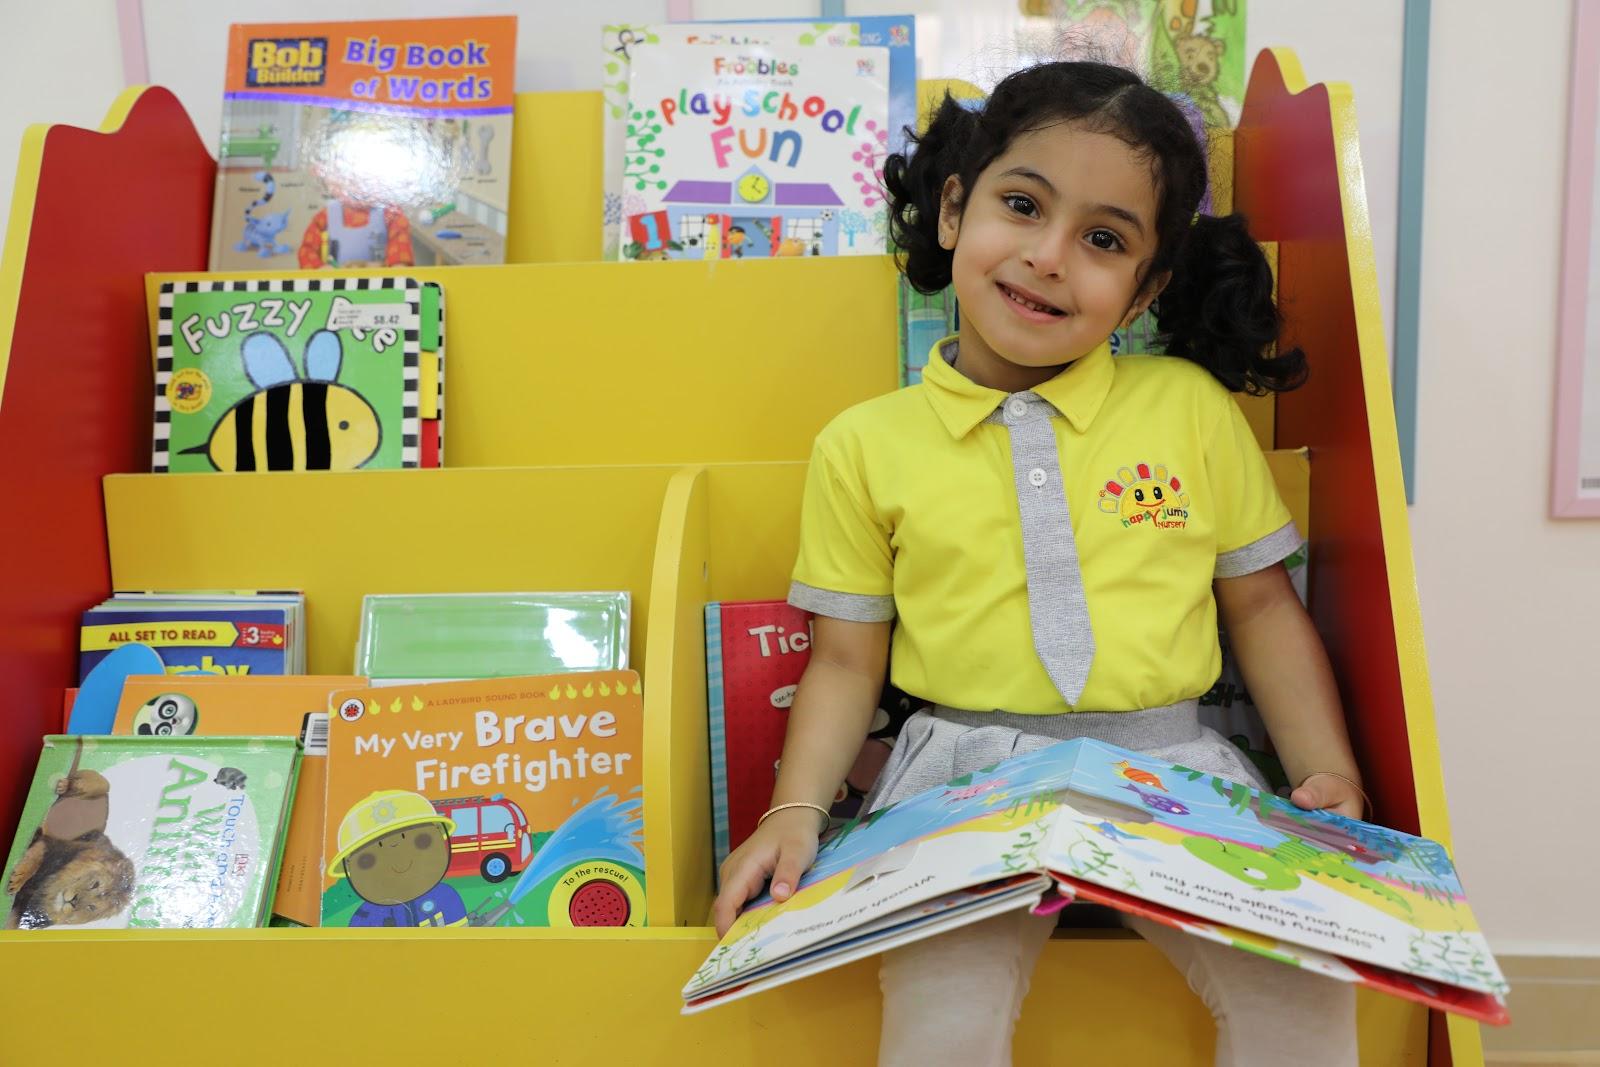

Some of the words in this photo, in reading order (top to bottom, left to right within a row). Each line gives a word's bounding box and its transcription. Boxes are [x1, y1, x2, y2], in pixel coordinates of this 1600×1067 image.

[252, 41, 323, 68] Bob
[346, 39, 397, 70] Big
[407, 42, 487, 67] Book
[714, 57, 799, 76] Froobles
[256, 69, 321, 84] Builder
[352, 78, 378, 97] of
[388, 76, 492, 99] Words
[373, 314, 400, 325] $8.42
[108, 630, 131, 643] ALL
[135, 629, 158, 642] SET
[160, 629, 178, 641] TO
[183, 629, 217, 641] READ
[246, 626, 260, 644] 3
[748, 620, 814, 657] Tic
[436, 696, 481, 706] LADYBIRD
[486, 693, 517, 702] SOUND
[520, 691, 546, 700] BOOK
[354, 734, 397, 757] My
[402, 730, 463, 751] Very
[475, 710, 618, 747] Brave
[416, 747, 632, 792] Firefighter
[563, 877, 575, 886] To
[575, 868, 591, 878] the
[594, 867, 629, 882] rescue!
[1164, 885, 1191, 899] me
[1193, 884, 1235, 902] your
[1205, 897, 1242, 917] show
[1304, 914, 1341, 932] you
